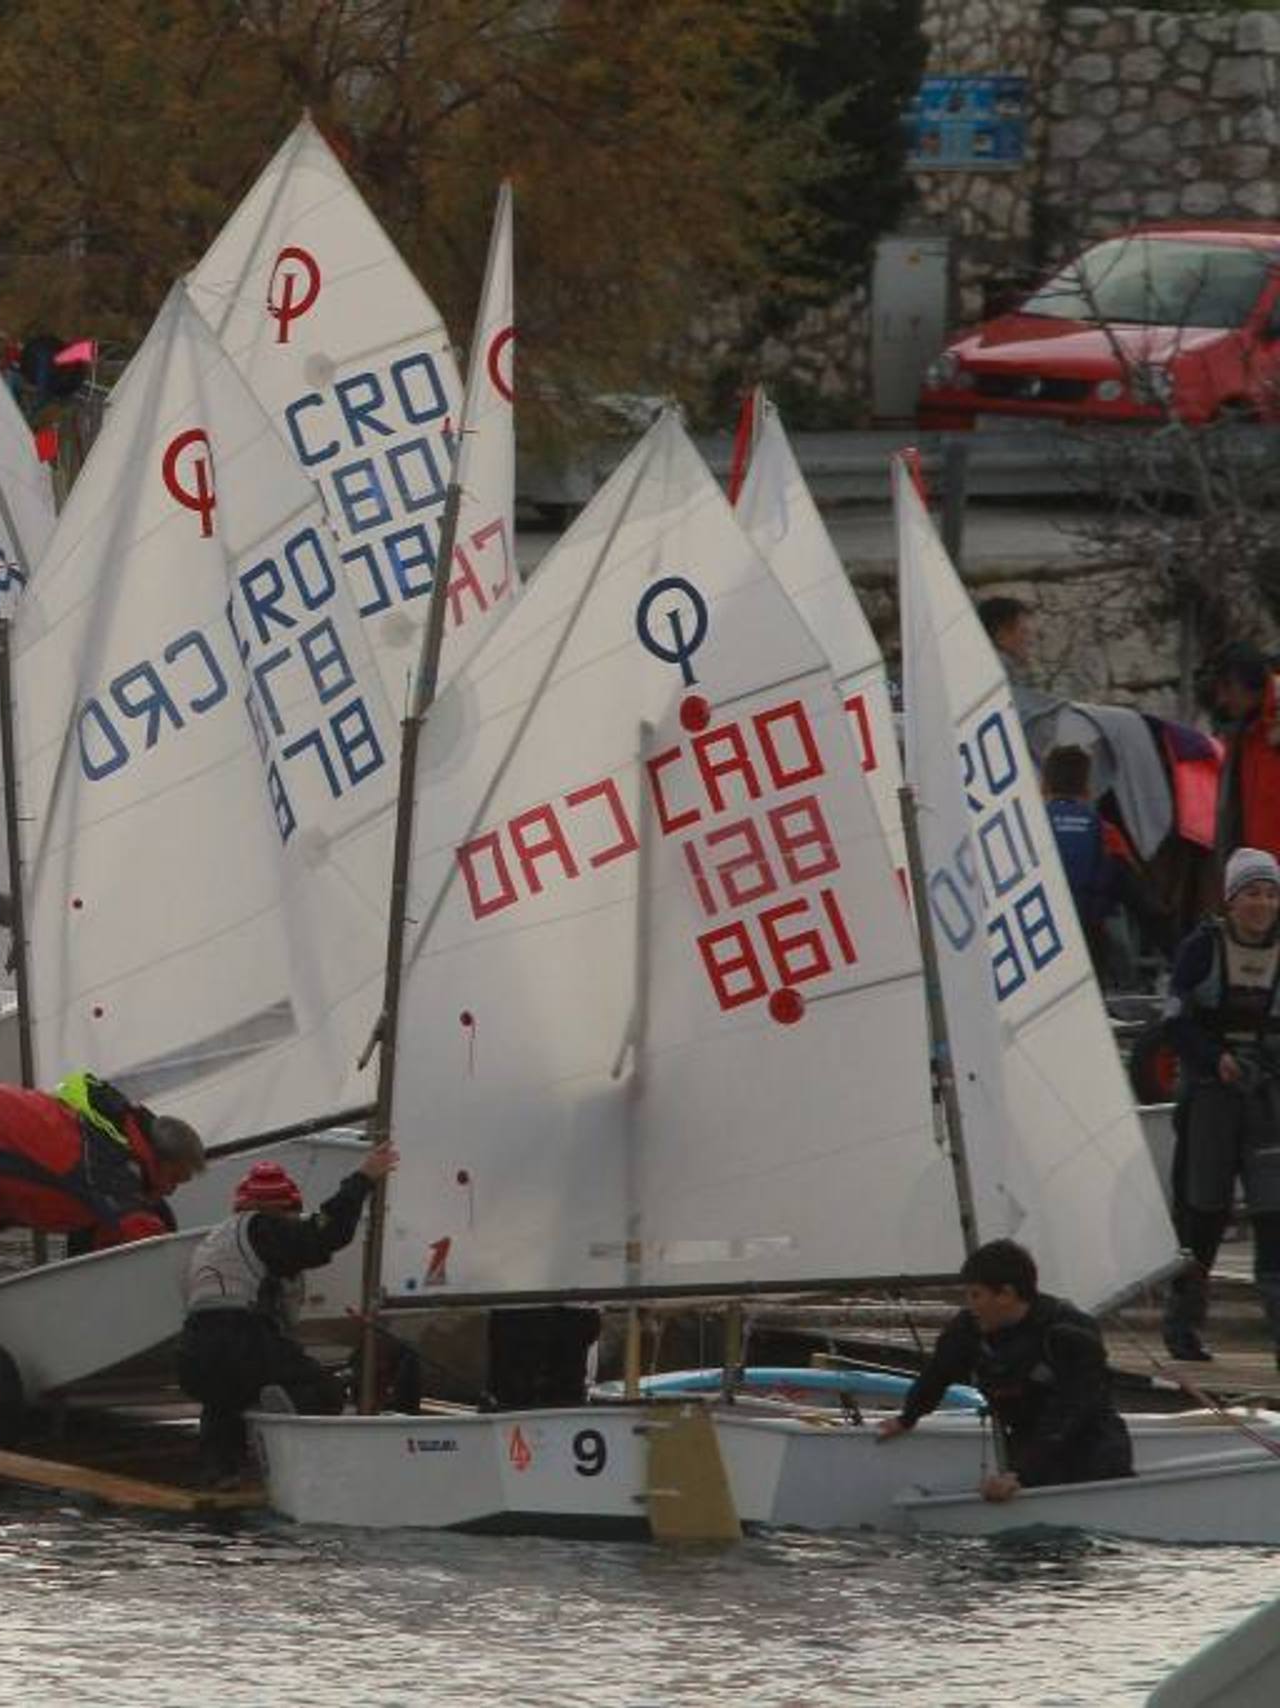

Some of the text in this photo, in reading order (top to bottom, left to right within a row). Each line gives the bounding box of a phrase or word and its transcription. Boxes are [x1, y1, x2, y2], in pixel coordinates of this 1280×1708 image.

[285, 353, 448, 466] CRO
[696, 888, 858, 1011] 861
[573, 1430, 607, 1477] 9
